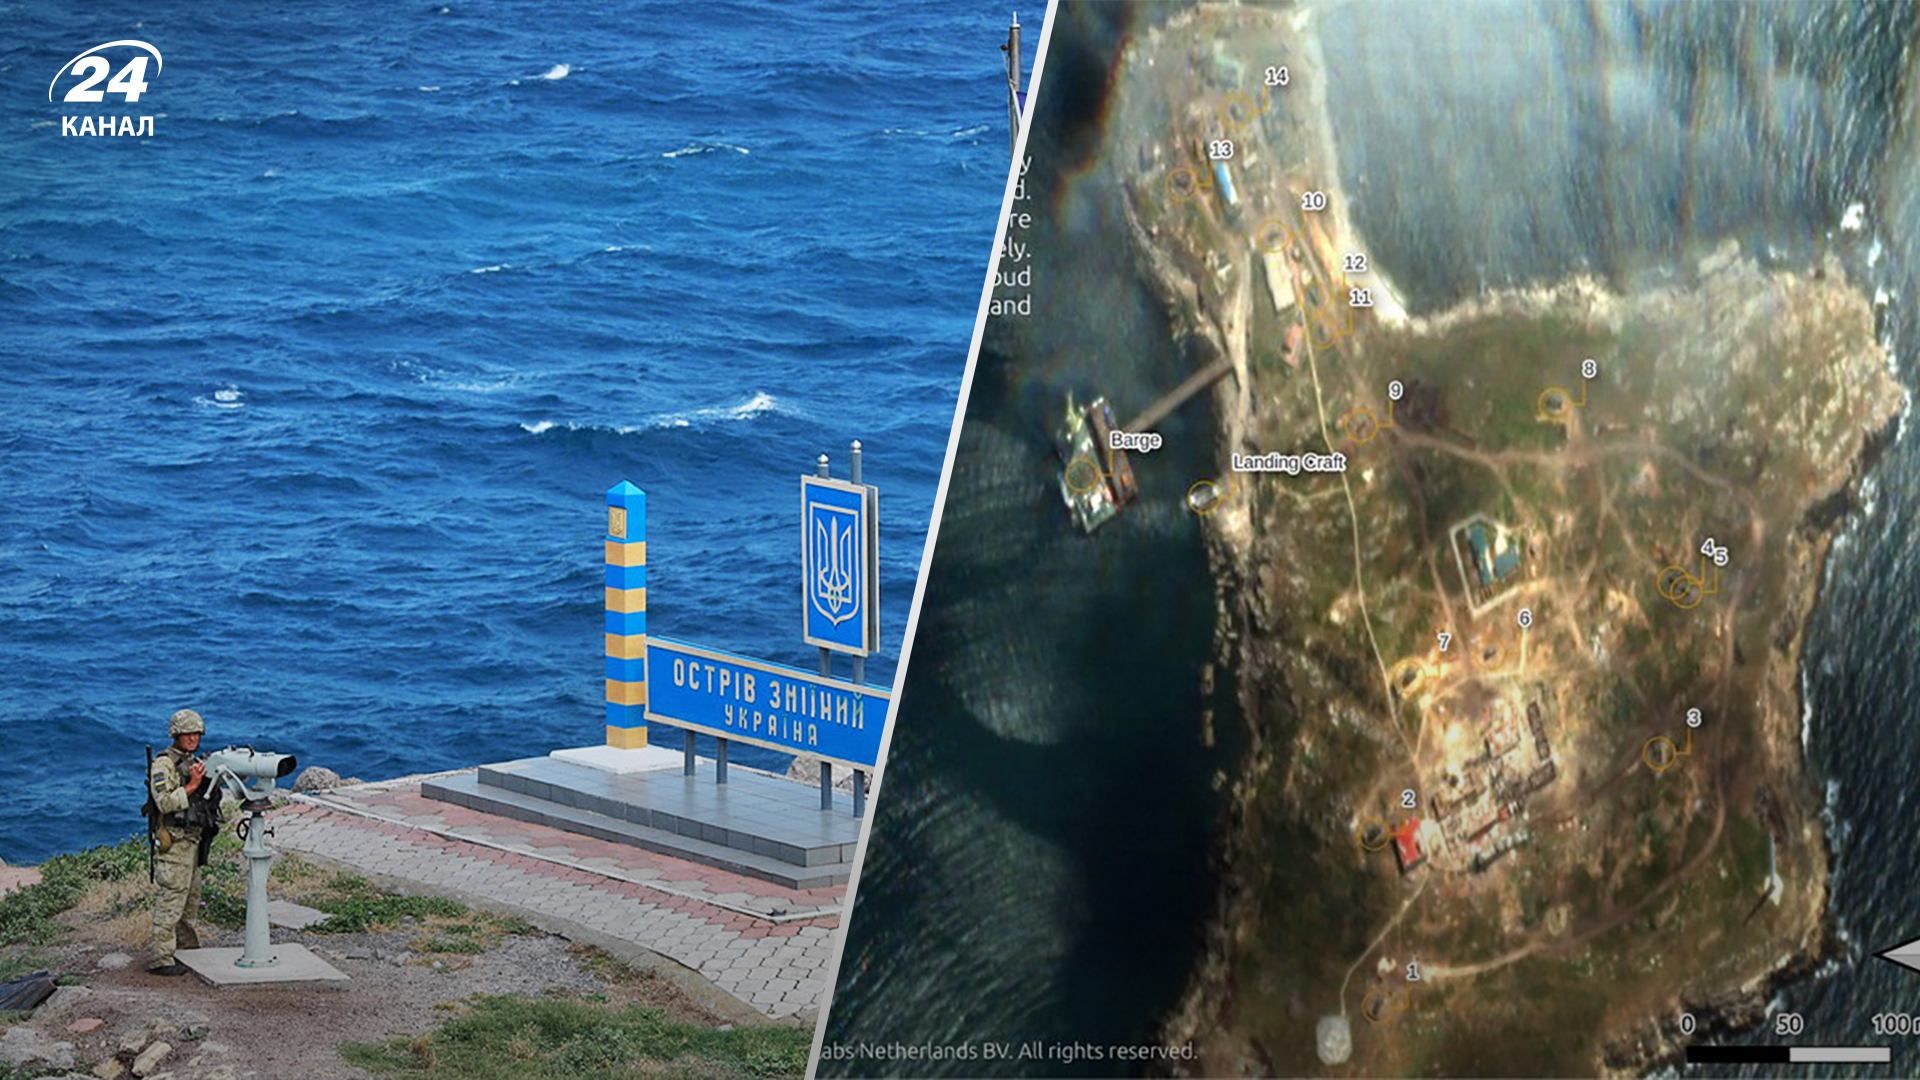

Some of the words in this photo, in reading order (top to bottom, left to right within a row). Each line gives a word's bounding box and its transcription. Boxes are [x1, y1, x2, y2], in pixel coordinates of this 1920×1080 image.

[673, 658, 756, 704] ОСТРІВ
[769, 681, 865, 730] ЗМІЇНИЙ
[724, 703, 817, 746] УКРАЇНА
